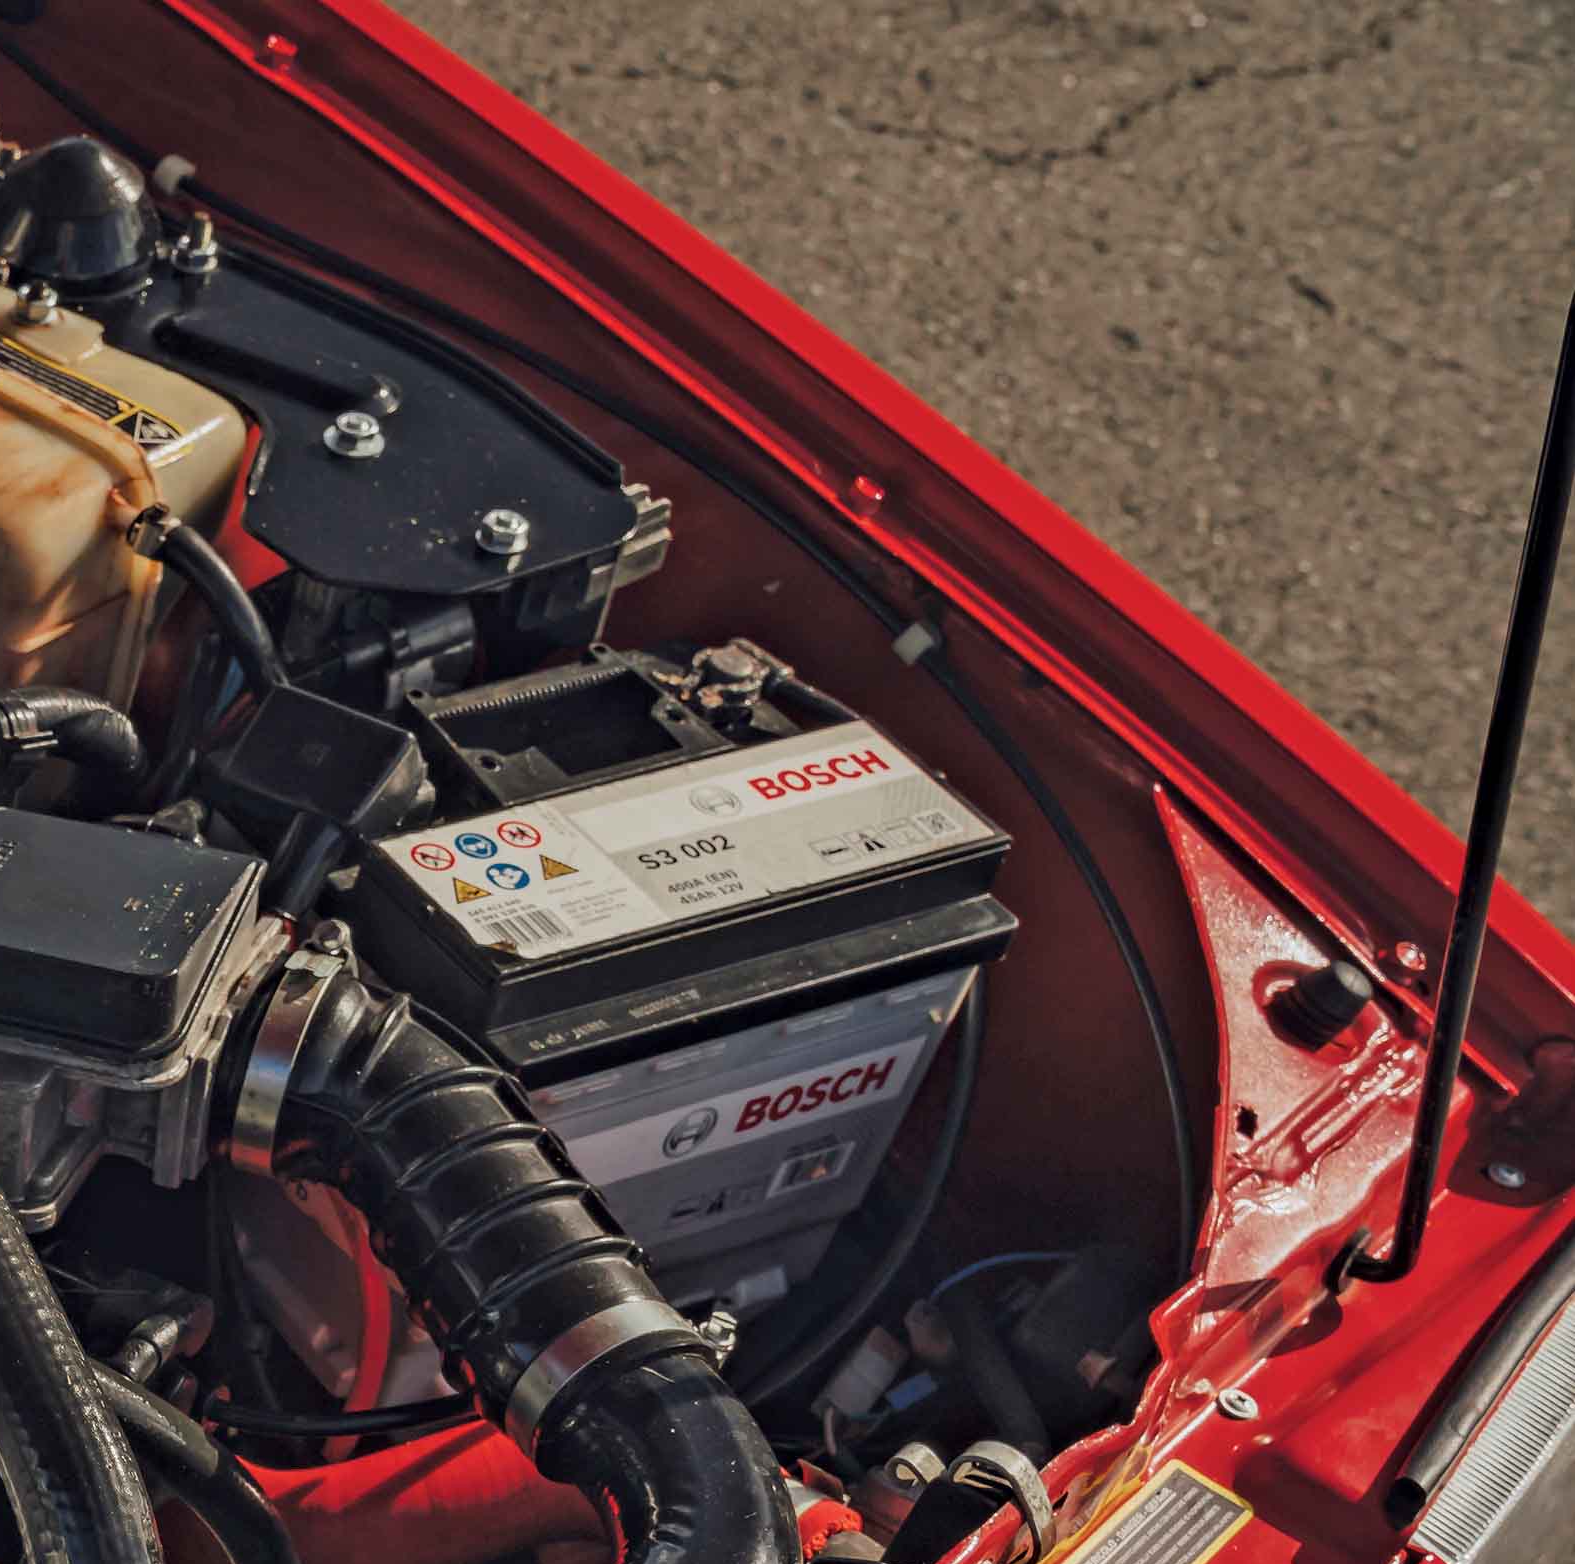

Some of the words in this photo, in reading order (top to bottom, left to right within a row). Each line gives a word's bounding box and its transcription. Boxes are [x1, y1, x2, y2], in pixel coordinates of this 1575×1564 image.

[747, 750, 891, 800] BOSCH
[638, 849, 678, 870] S3
[680, 835, 736, 859] 002
[733, 1055, 898, 1133] BOSCH
